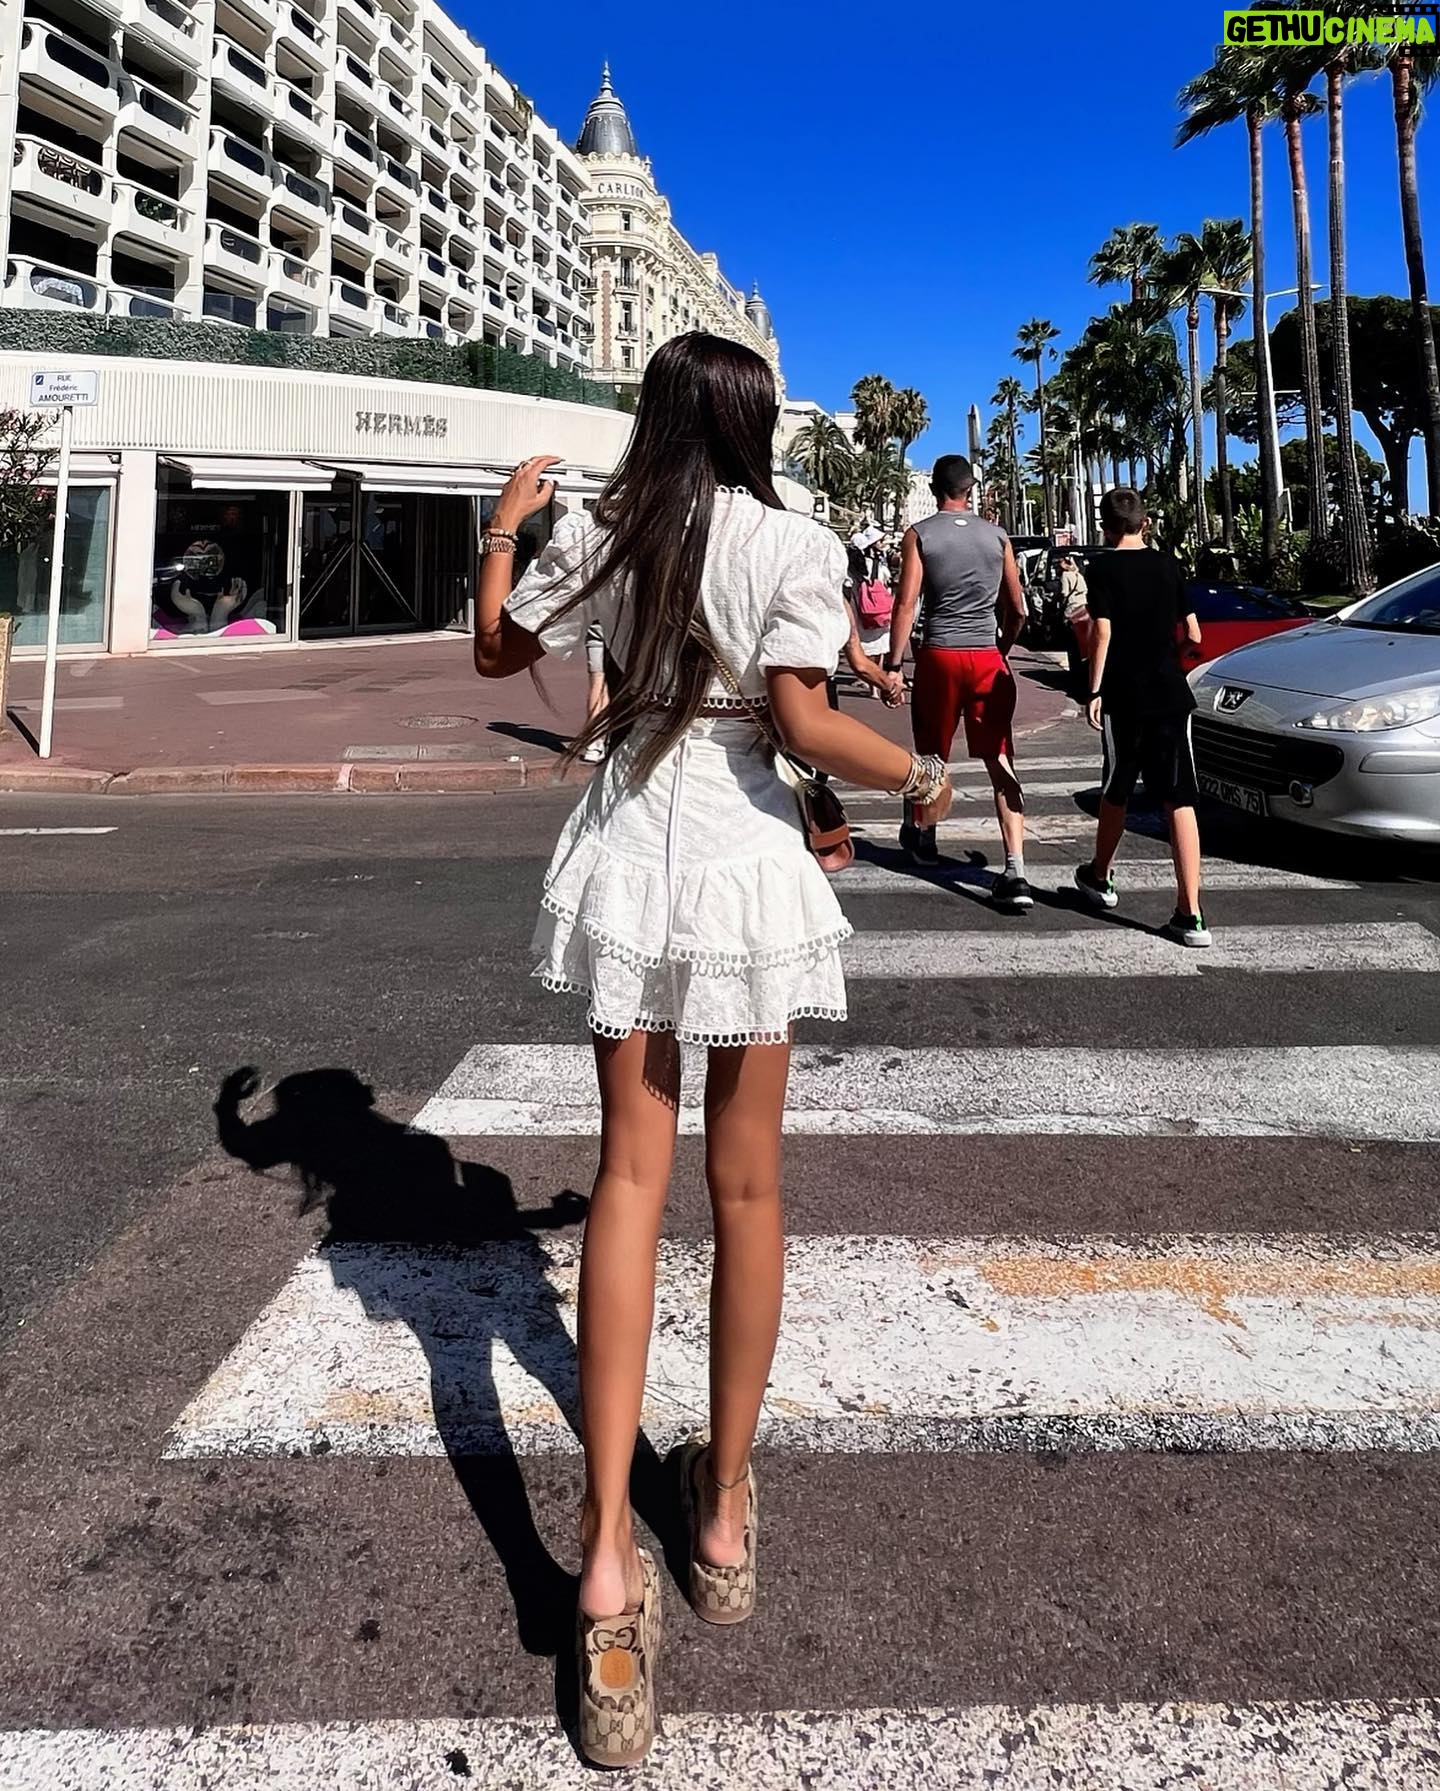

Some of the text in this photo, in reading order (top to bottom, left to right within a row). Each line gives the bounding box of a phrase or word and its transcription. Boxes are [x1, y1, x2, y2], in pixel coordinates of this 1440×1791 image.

[598, 183, 644, 198] CARLTON
[57, 374, 72, 382] RUE
[38, 392, 89, 402] AMOURETTI
